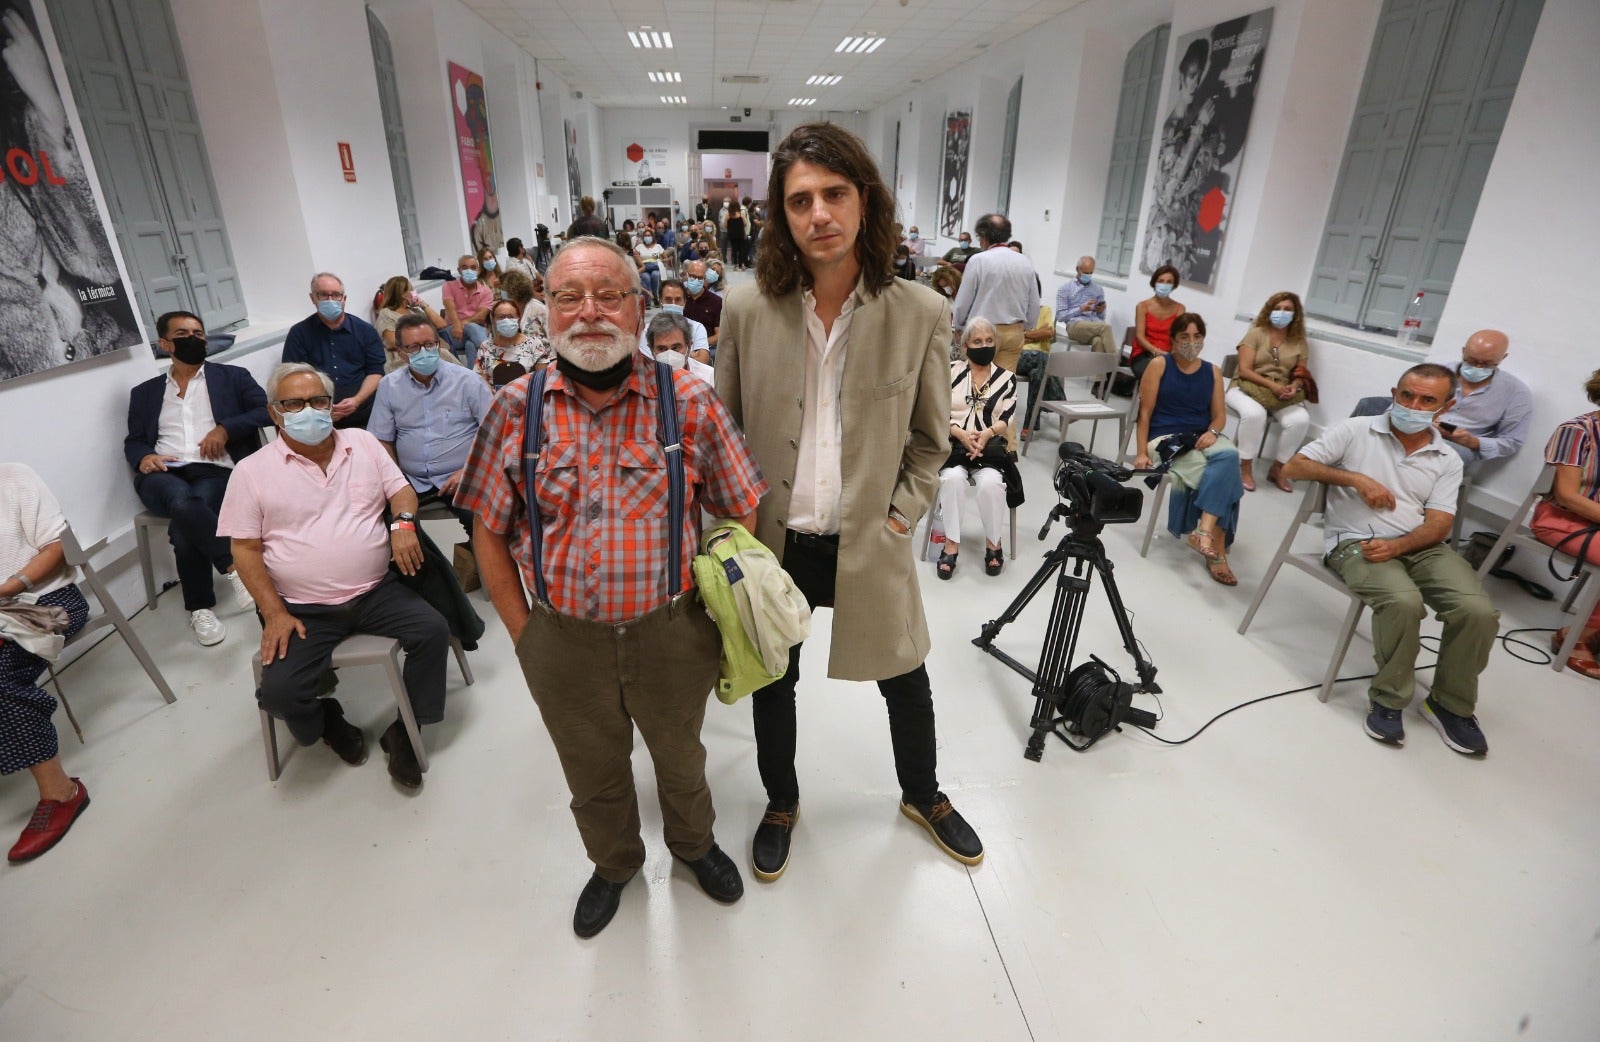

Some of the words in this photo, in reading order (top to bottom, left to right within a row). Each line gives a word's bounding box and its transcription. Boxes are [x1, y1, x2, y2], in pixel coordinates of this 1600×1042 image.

[0, 146, 66, 187] OL
[77, 288, 88, 301] la
[87, 284, 116, 299] térmica
